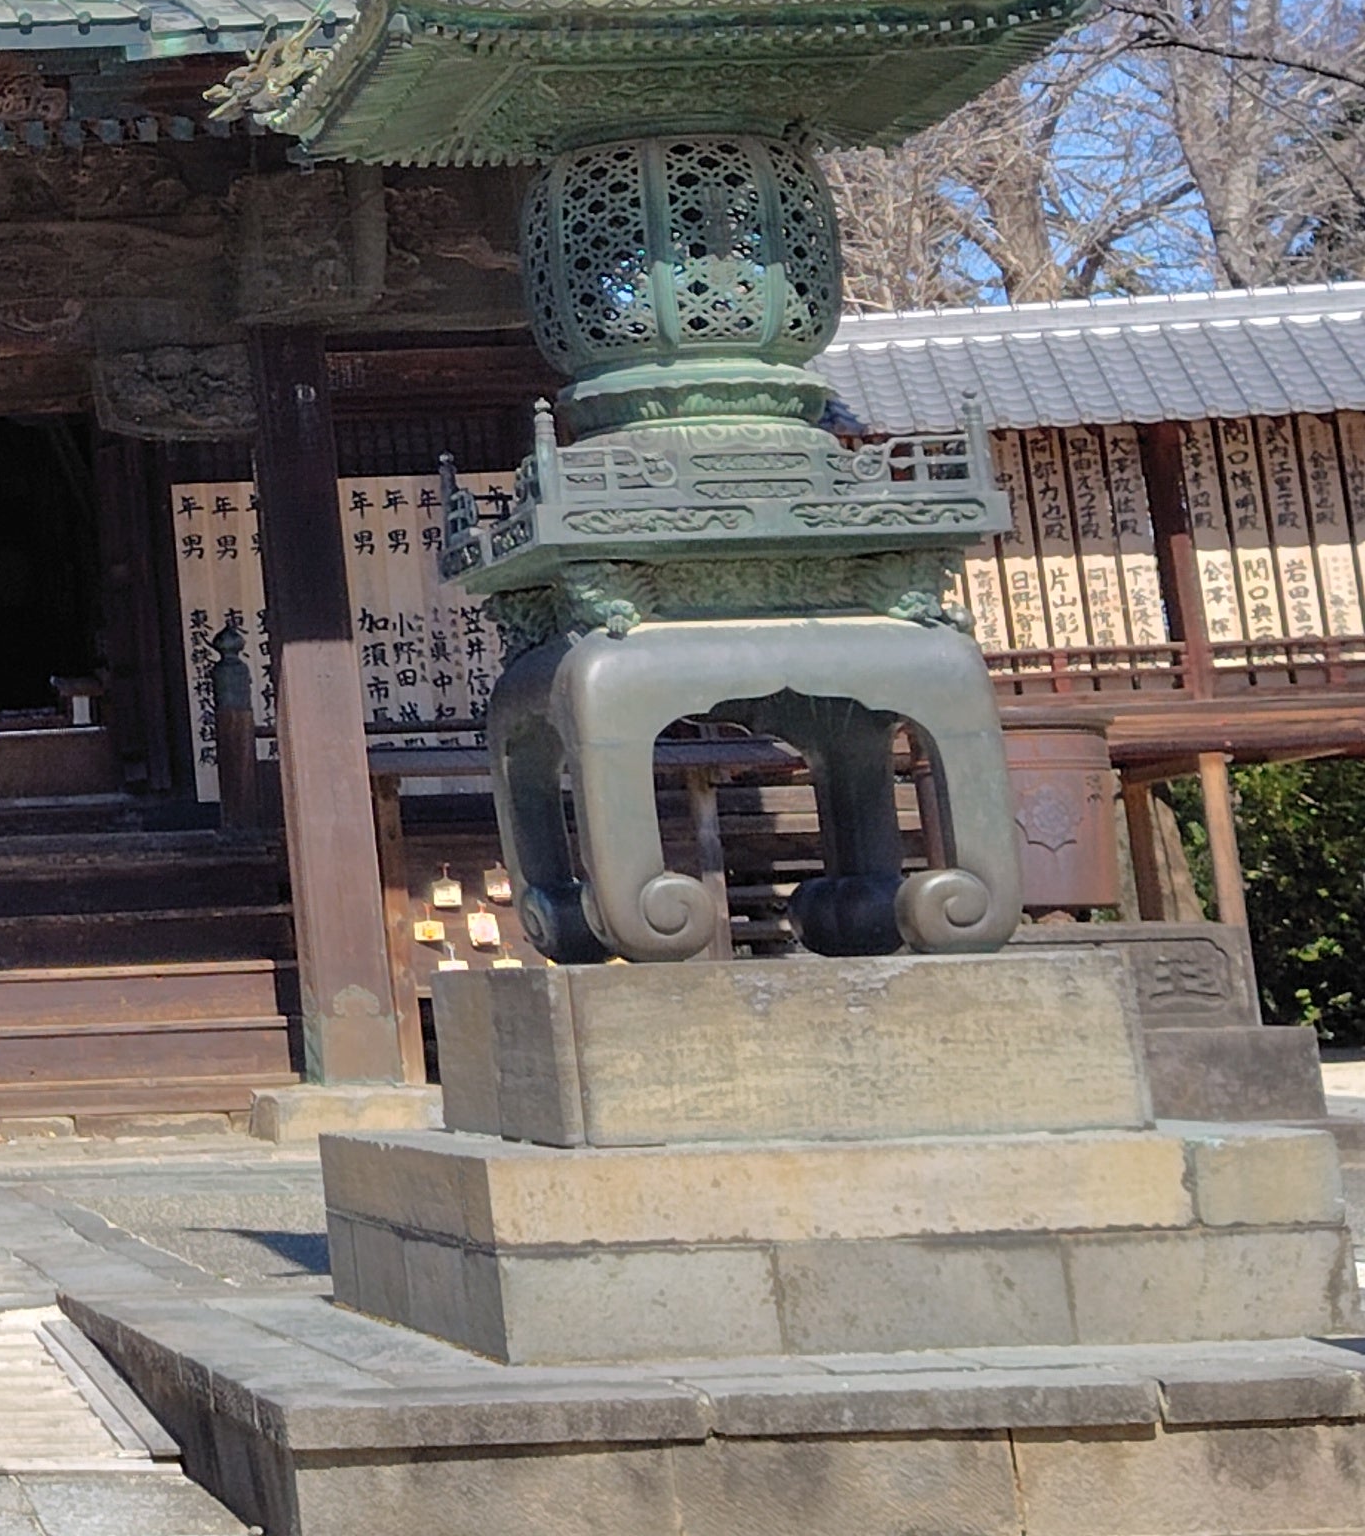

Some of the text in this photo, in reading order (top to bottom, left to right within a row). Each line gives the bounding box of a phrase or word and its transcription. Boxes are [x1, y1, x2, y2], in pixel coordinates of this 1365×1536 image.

[177, 495, 204, 560] 年男
[211, 495, 239, 561] 年男
[349, 490, 375, 556] 年男
[382, 489, 410, 555] 年男
[417, 488, 443, 552] 年男
